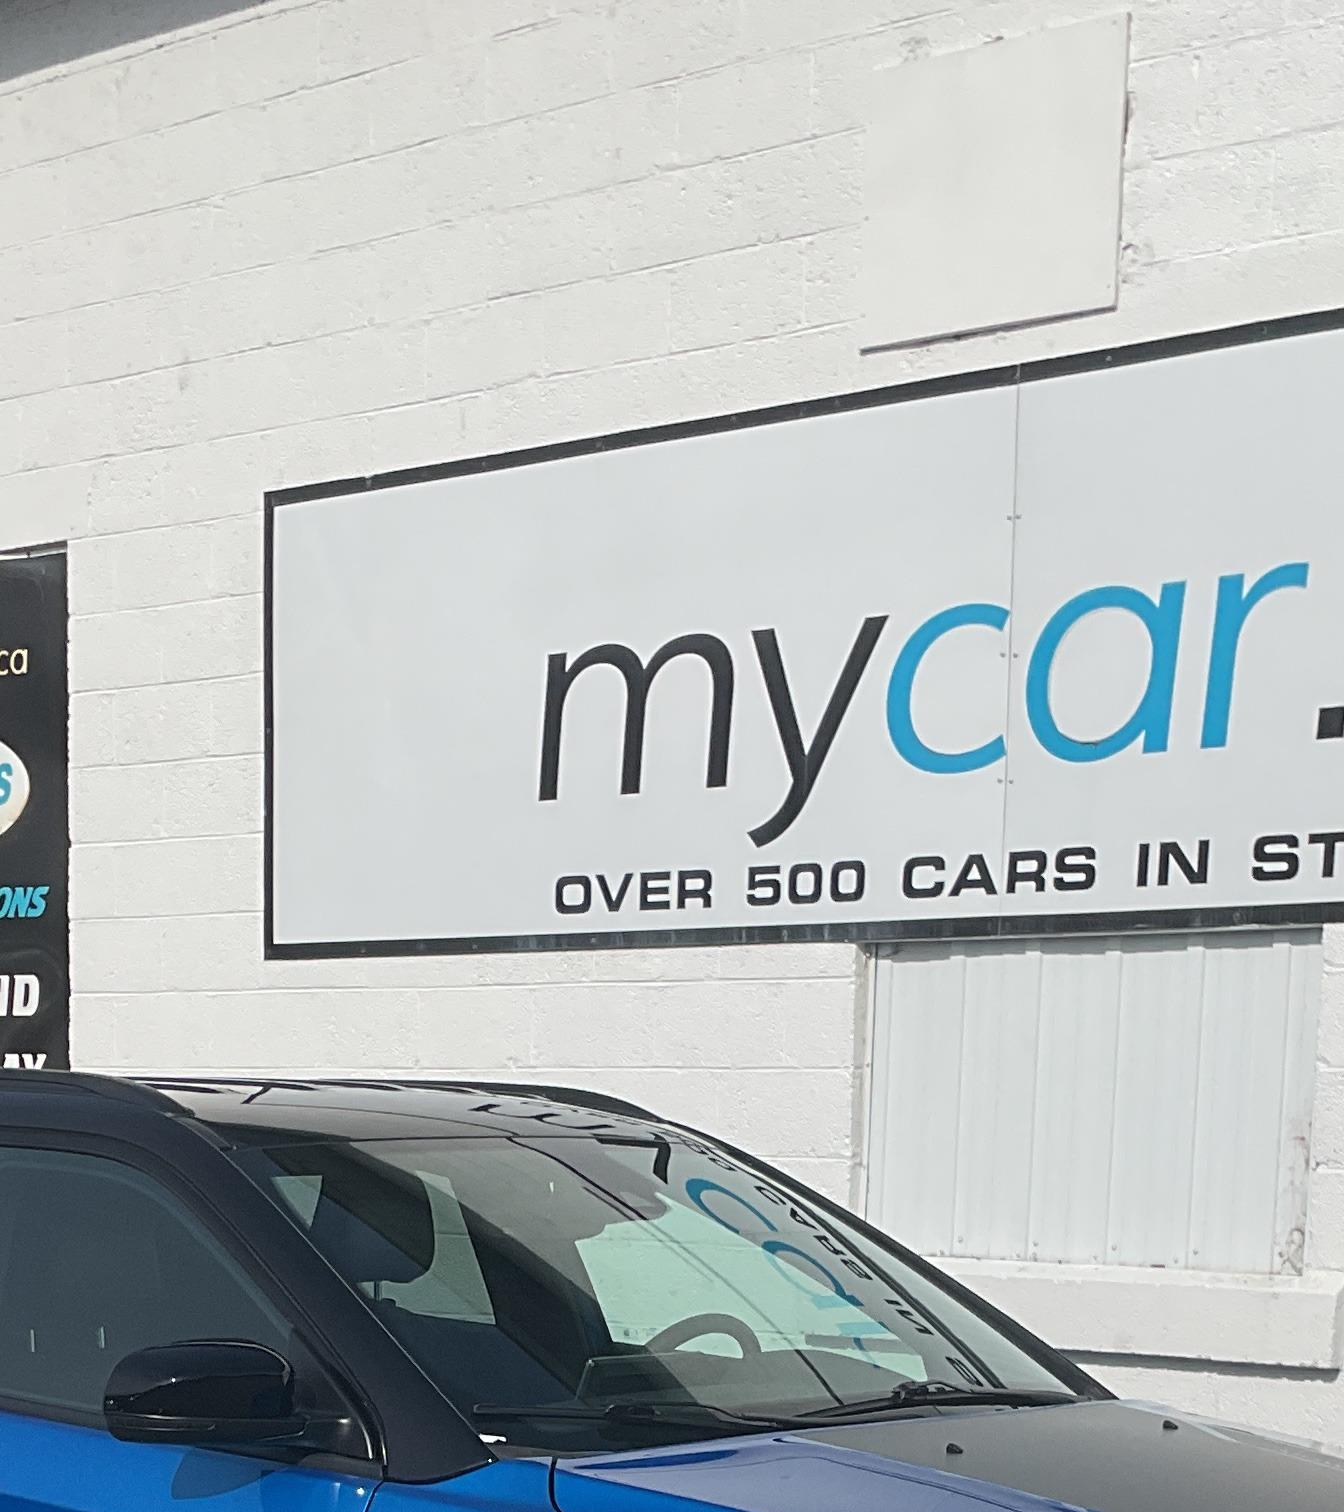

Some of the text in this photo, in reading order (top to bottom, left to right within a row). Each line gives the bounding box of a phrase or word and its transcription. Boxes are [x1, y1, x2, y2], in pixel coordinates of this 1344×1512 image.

[554, 870, 713, 916] OVER
[745, 859, 867, 907] 500
[901, 845, 1097, 900] CARS
[1135, 838, 1211, 888] IN
